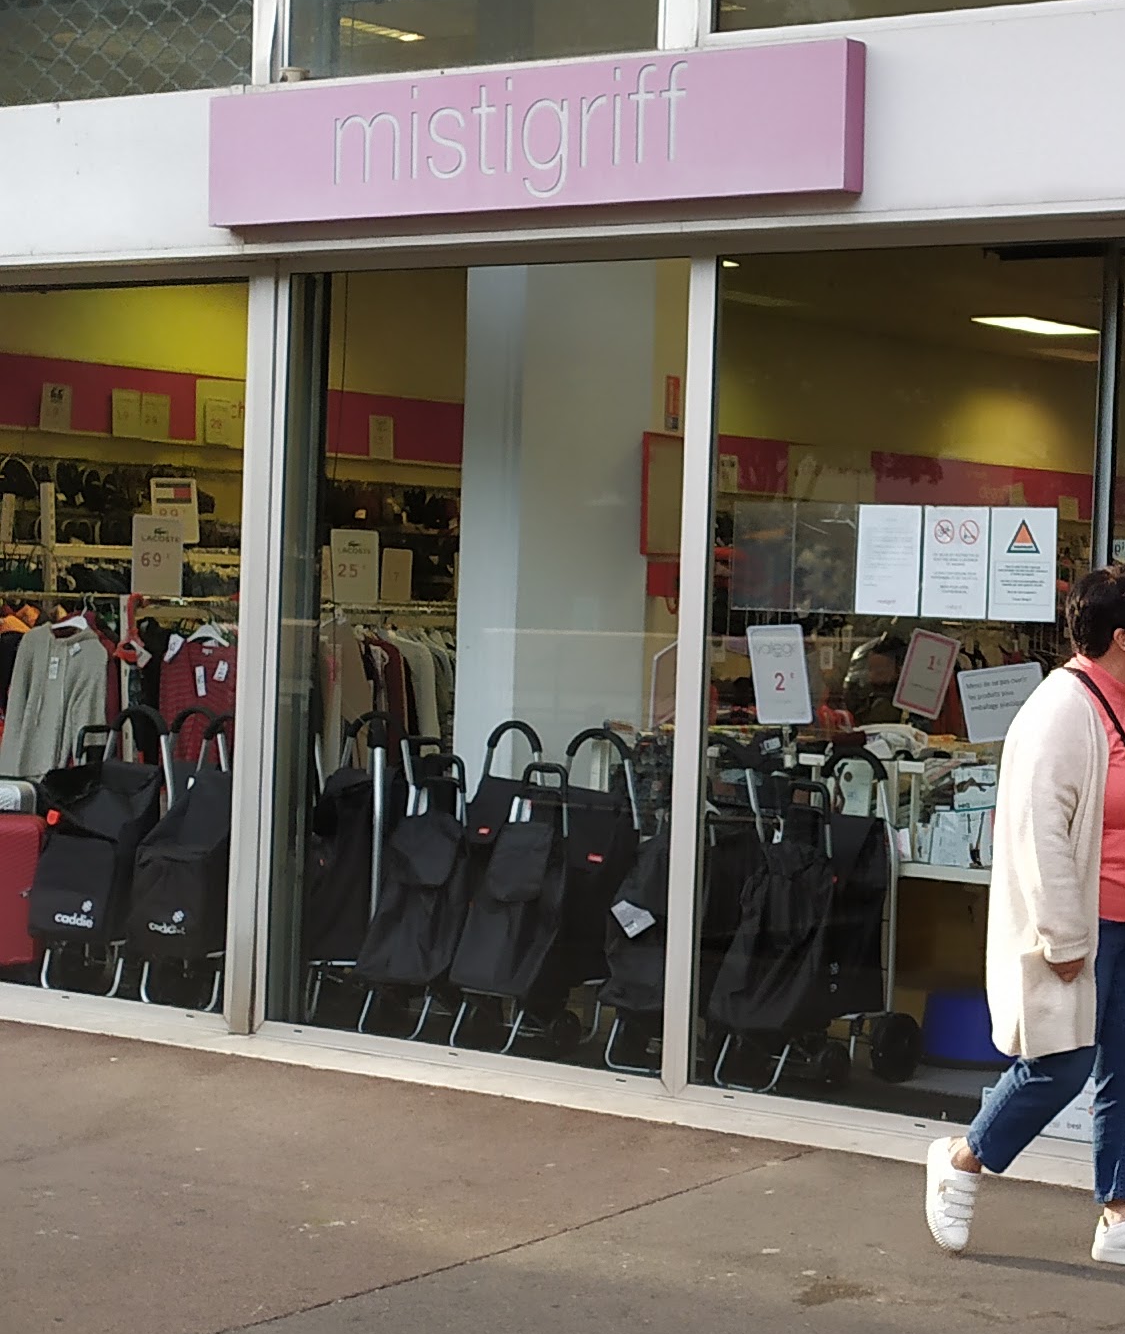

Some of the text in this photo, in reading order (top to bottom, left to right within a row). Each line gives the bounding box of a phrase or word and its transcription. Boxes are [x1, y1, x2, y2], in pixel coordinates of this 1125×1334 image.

[333, 60, 689, 198] mistigriff
[141, 551, 162, 568] 69
[338, 563, 358, 578] 25
[774, 672, 785, 691] 2
[54, 912, 94, 928] caddie
